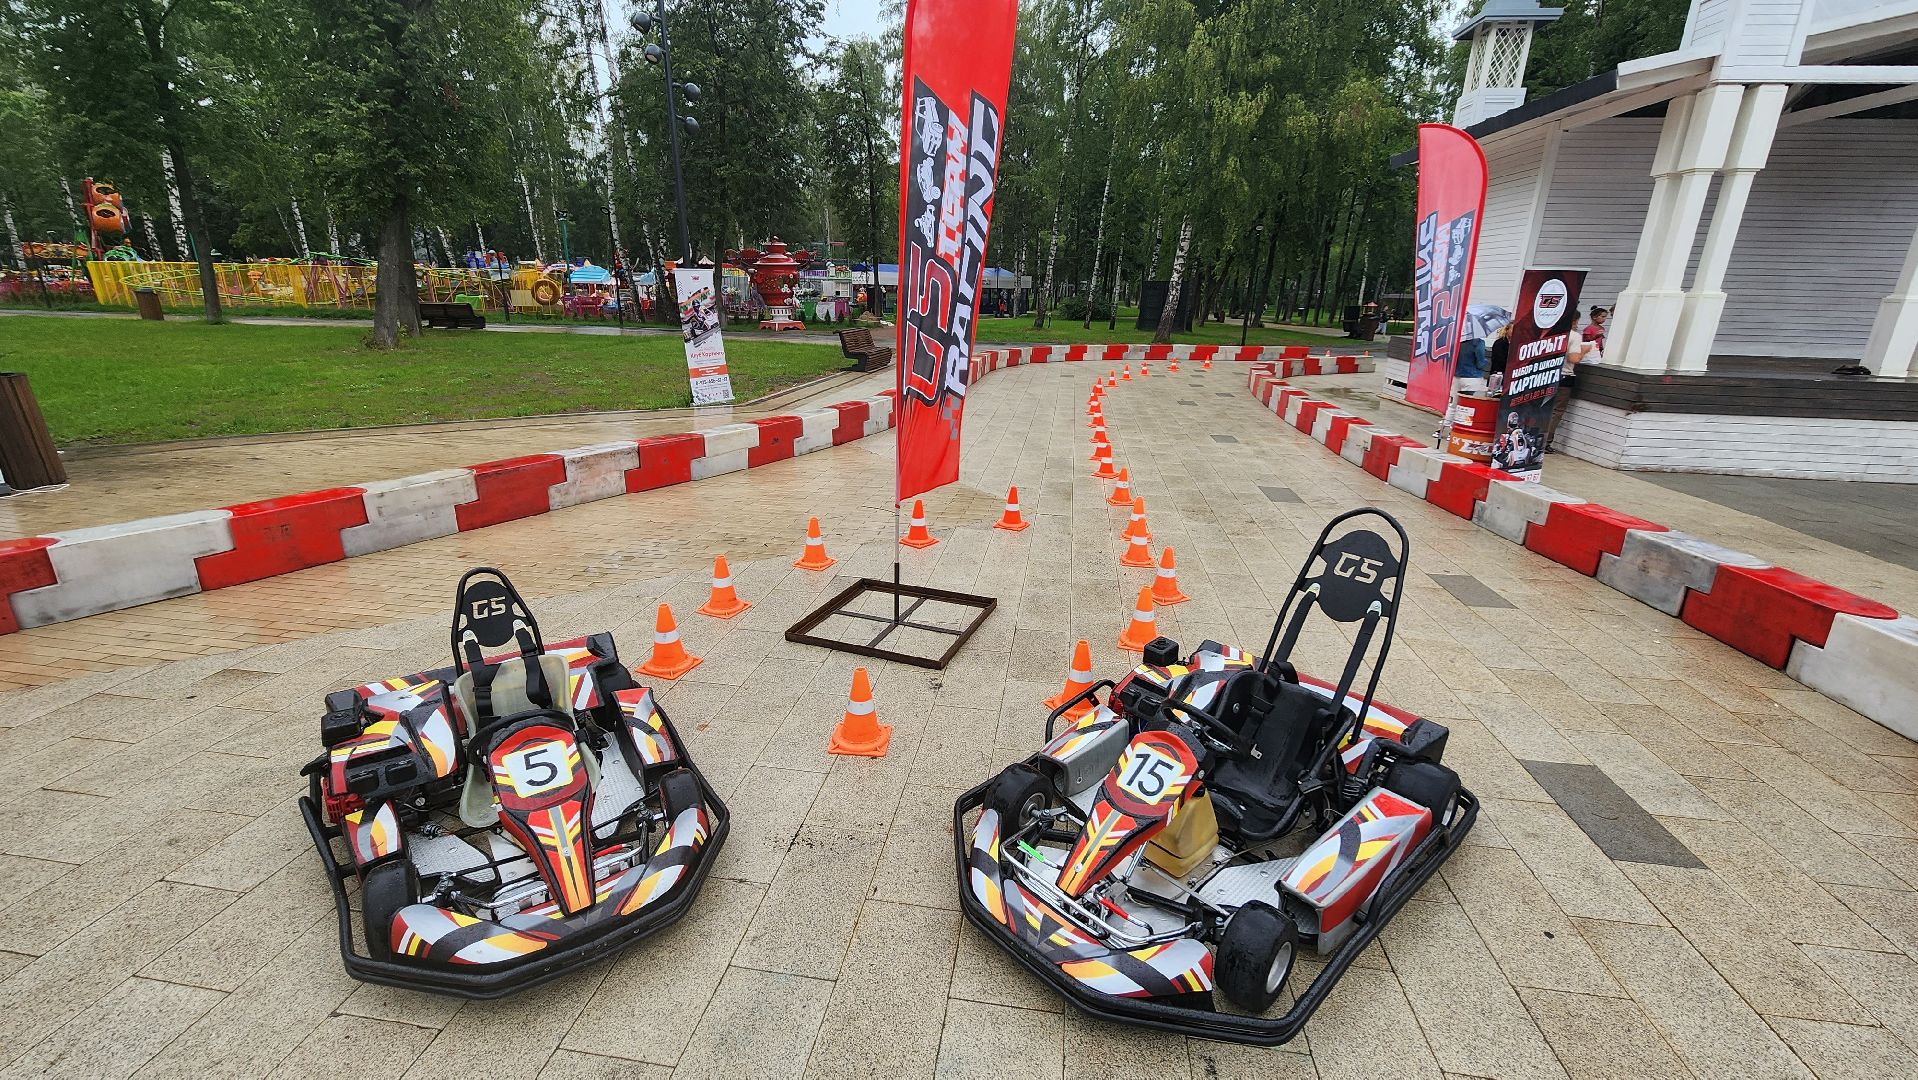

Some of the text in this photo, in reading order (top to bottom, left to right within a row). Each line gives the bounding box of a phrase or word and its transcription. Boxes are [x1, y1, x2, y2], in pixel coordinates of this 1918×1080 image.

[944, 98, 998, 396] RACING
[1519, 335, 1567, 361] ОТКРЫТ
[1512, 356, 1565, 378] НАБОР В ШКОЛУ
[1509, 369, 1560, 396] КАРТИНГА
[1333, 551, 1384, 584] GS
[471, 596, 506, 620] GS
[524, 748, 558, 787] 5
[1126, 753, 1175, 797] 15
